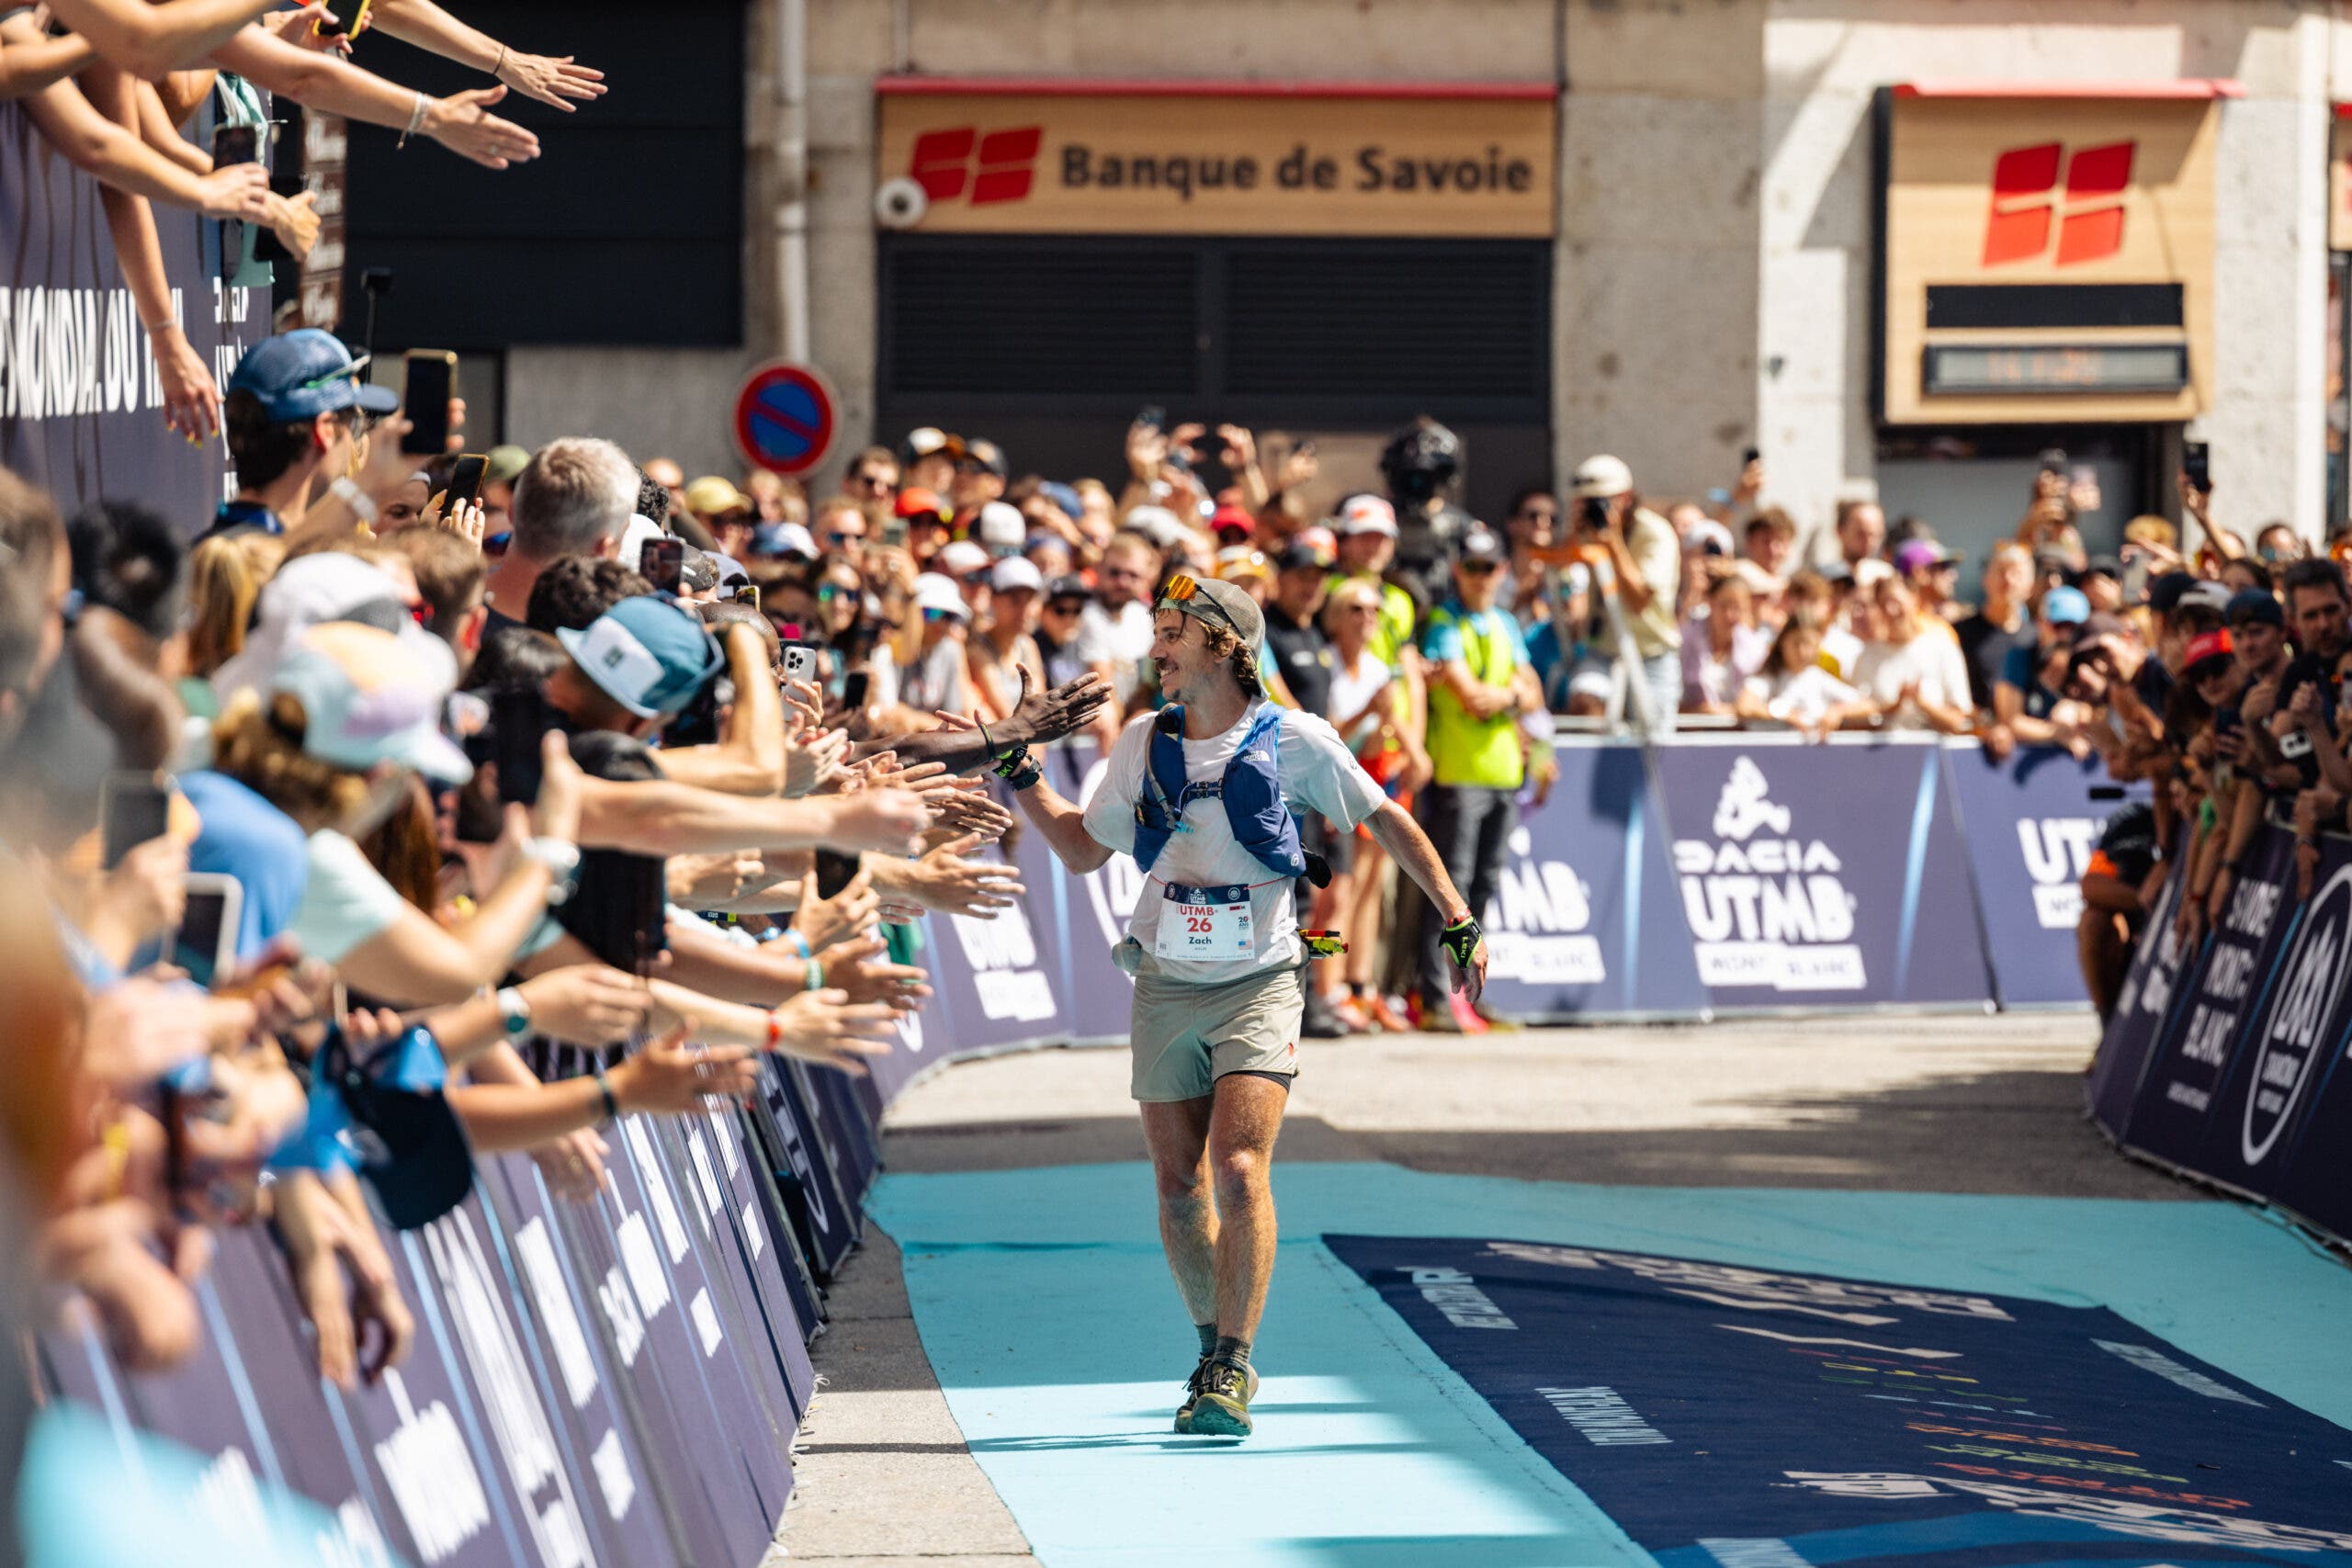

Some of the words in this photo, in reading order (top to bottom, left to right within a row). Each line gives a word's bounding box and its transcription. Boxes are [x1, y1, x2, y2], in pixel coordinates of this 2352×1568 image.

[1062, 147, 1259, 199] Banque
[1276, 145, 1337, 191] de
[1354, 147, 1532, 193] Savoie
[1673, 840, 1843, 874] DACIA
[1180, 905, 1215, 916] UTMB
[1485, 858, 1590, 932] MB
[1680, 873, 1854, 942] UTMB
[1186, 917, 1213, 932] 26
[1188, 936, 1212, 944] Zach
